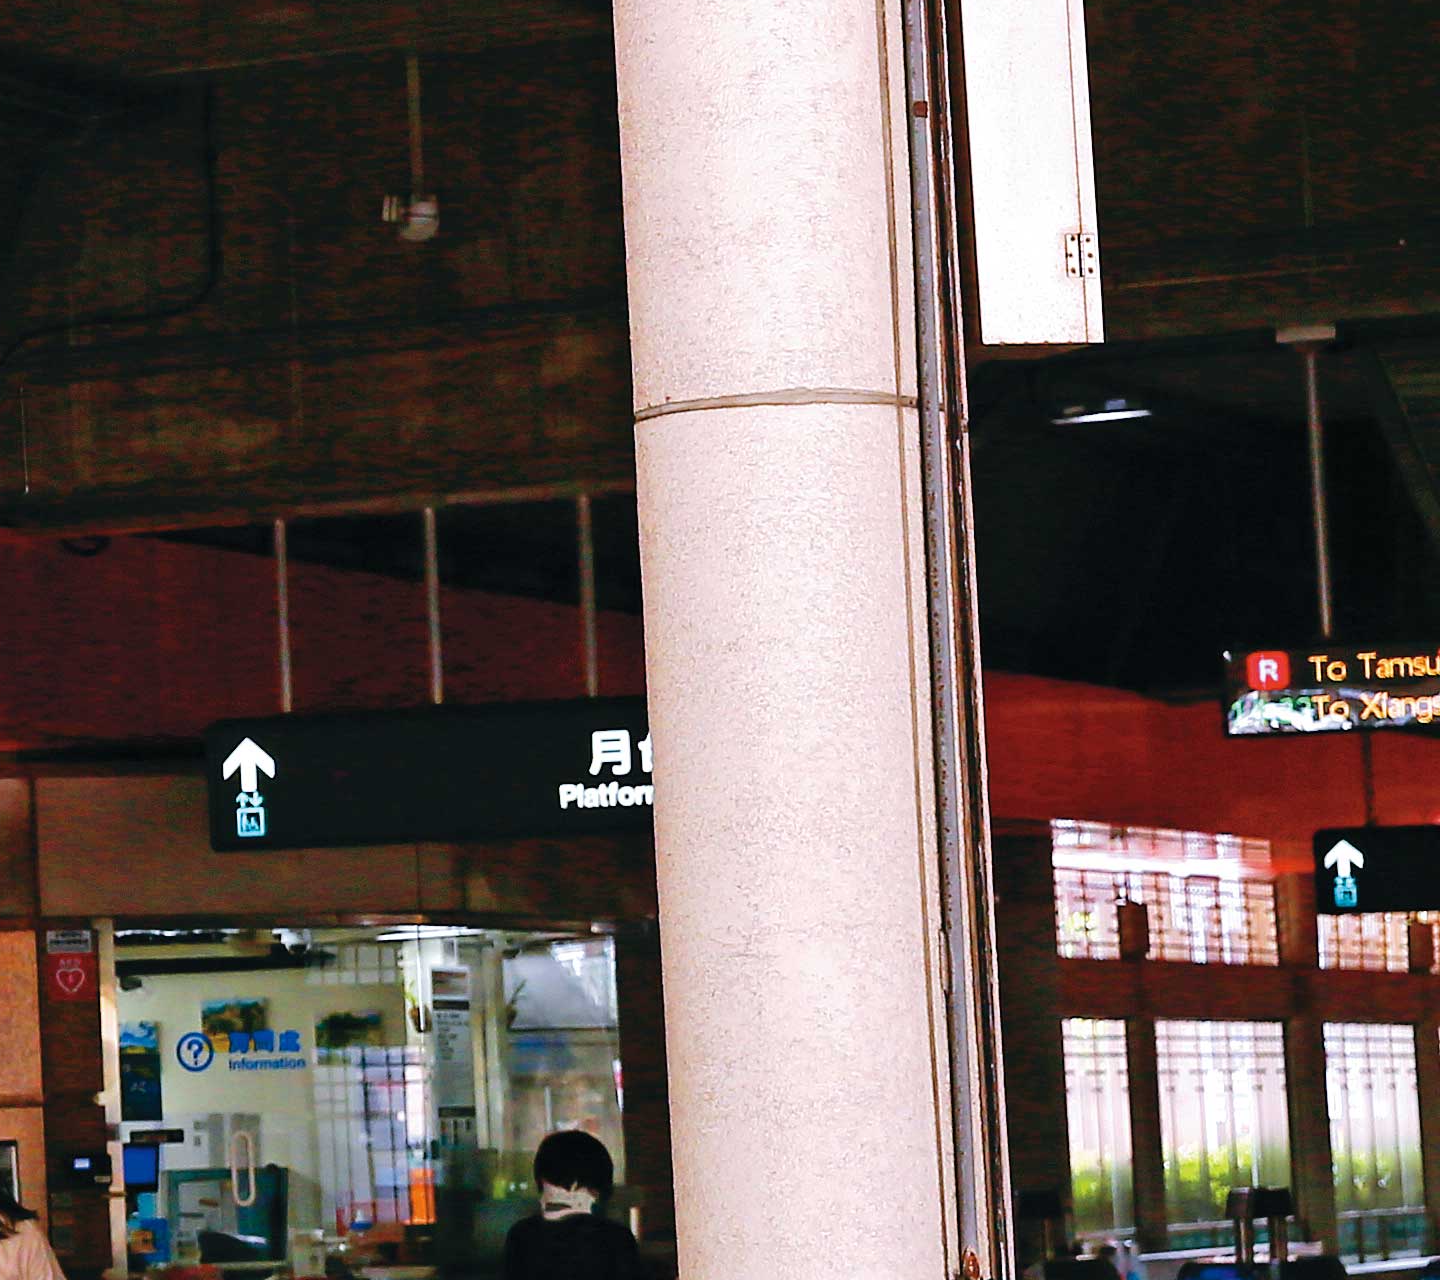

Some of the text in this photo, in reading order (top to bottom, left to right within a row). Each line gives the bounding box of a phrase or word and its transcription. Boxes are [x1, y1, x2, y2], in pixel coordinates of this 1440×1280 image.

[1258, 657, 1280, 683] R
[1307, 654, 1348, 683] To
[1311, 694, 1350, 721] To
